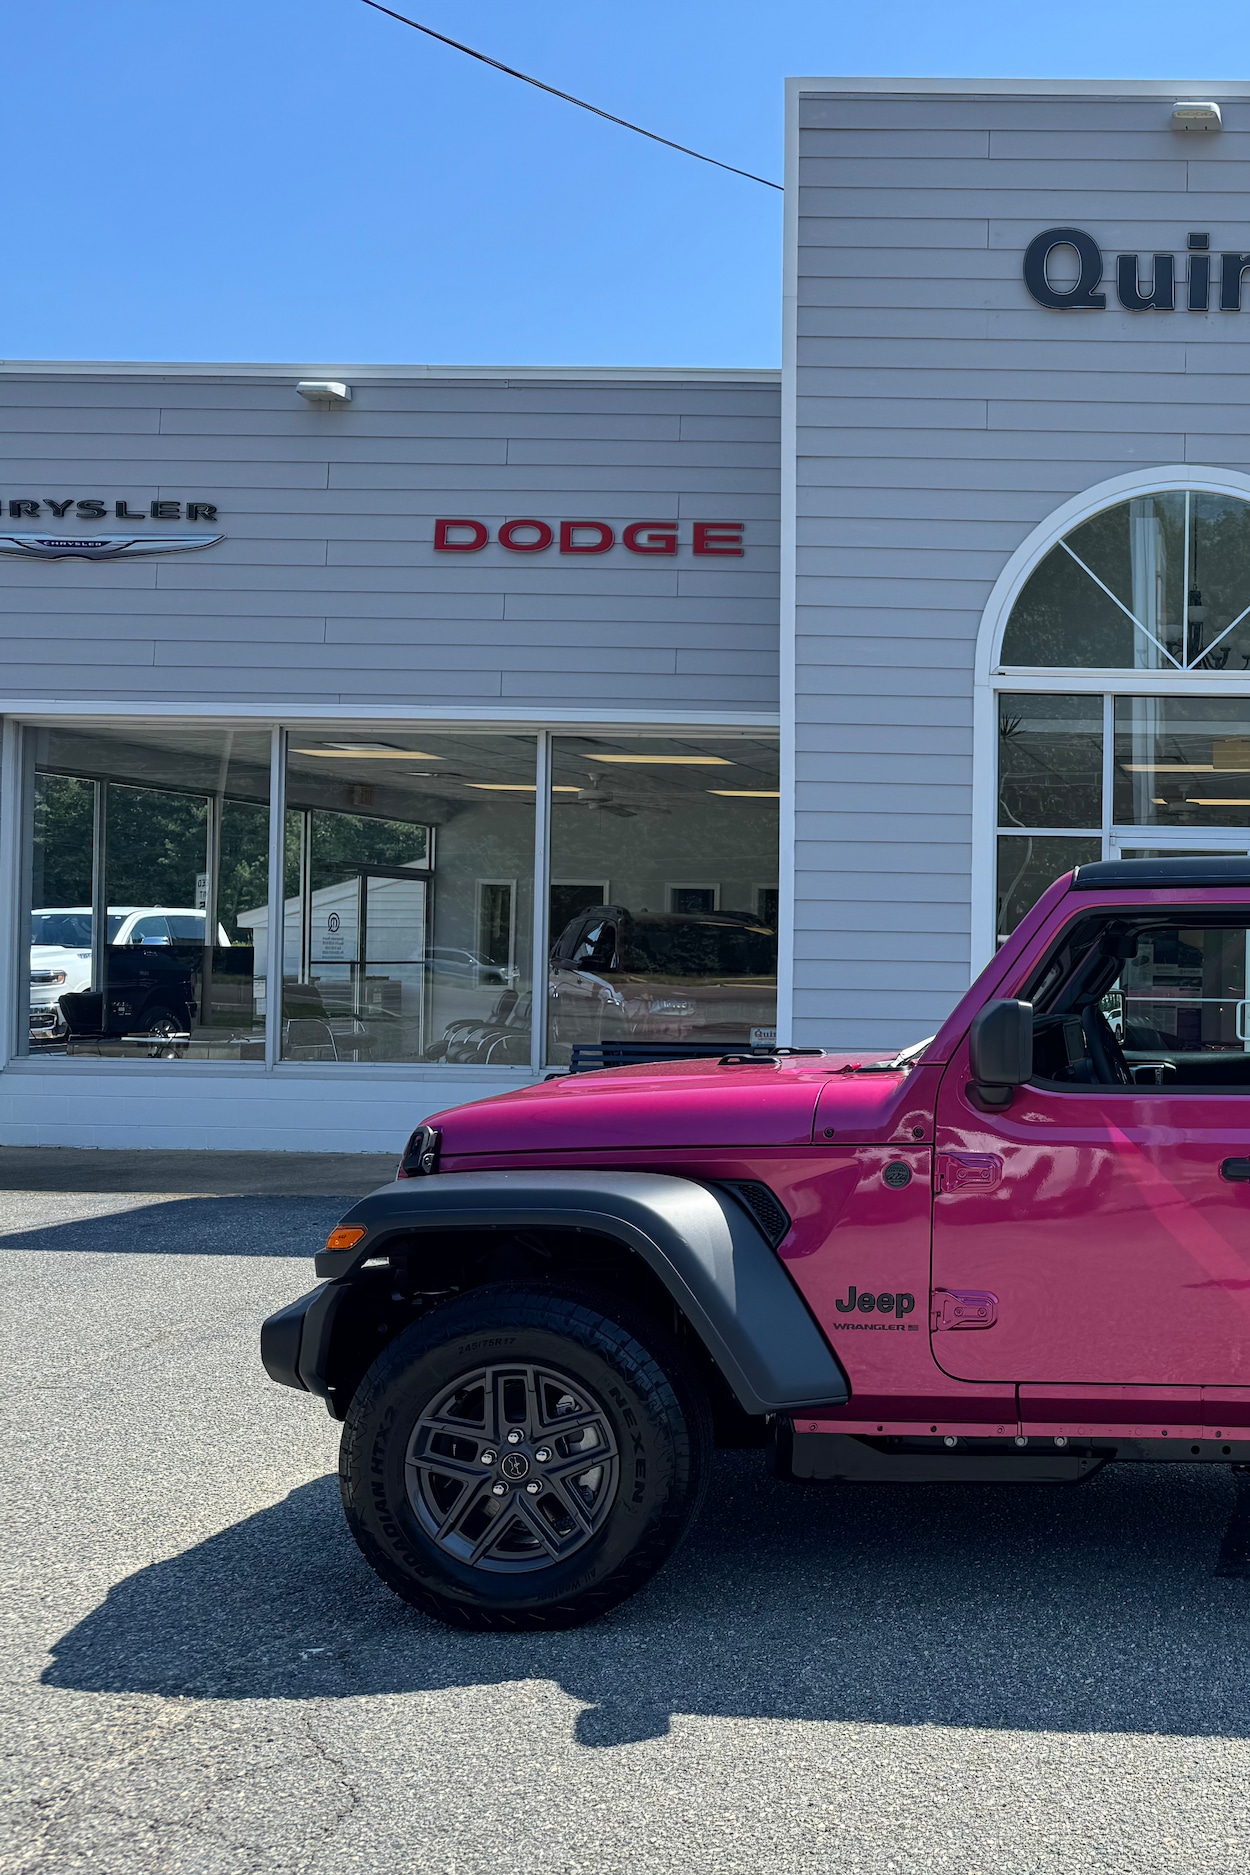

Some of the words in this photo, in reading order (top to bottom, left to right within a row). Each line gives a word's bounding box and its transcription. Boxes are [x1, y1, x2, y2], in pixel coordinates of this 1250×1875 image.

[0, 499, 217, 521] RYSLER
[434, 518, 745, 556] DODGE
[835, 1286, 915, 1319] Jeep
[833, 1323, 906, 1332] WRANGLER
[371, 1405, 396, 1474] HTX2
[608, 1386, 649, 1505] NEXEN
